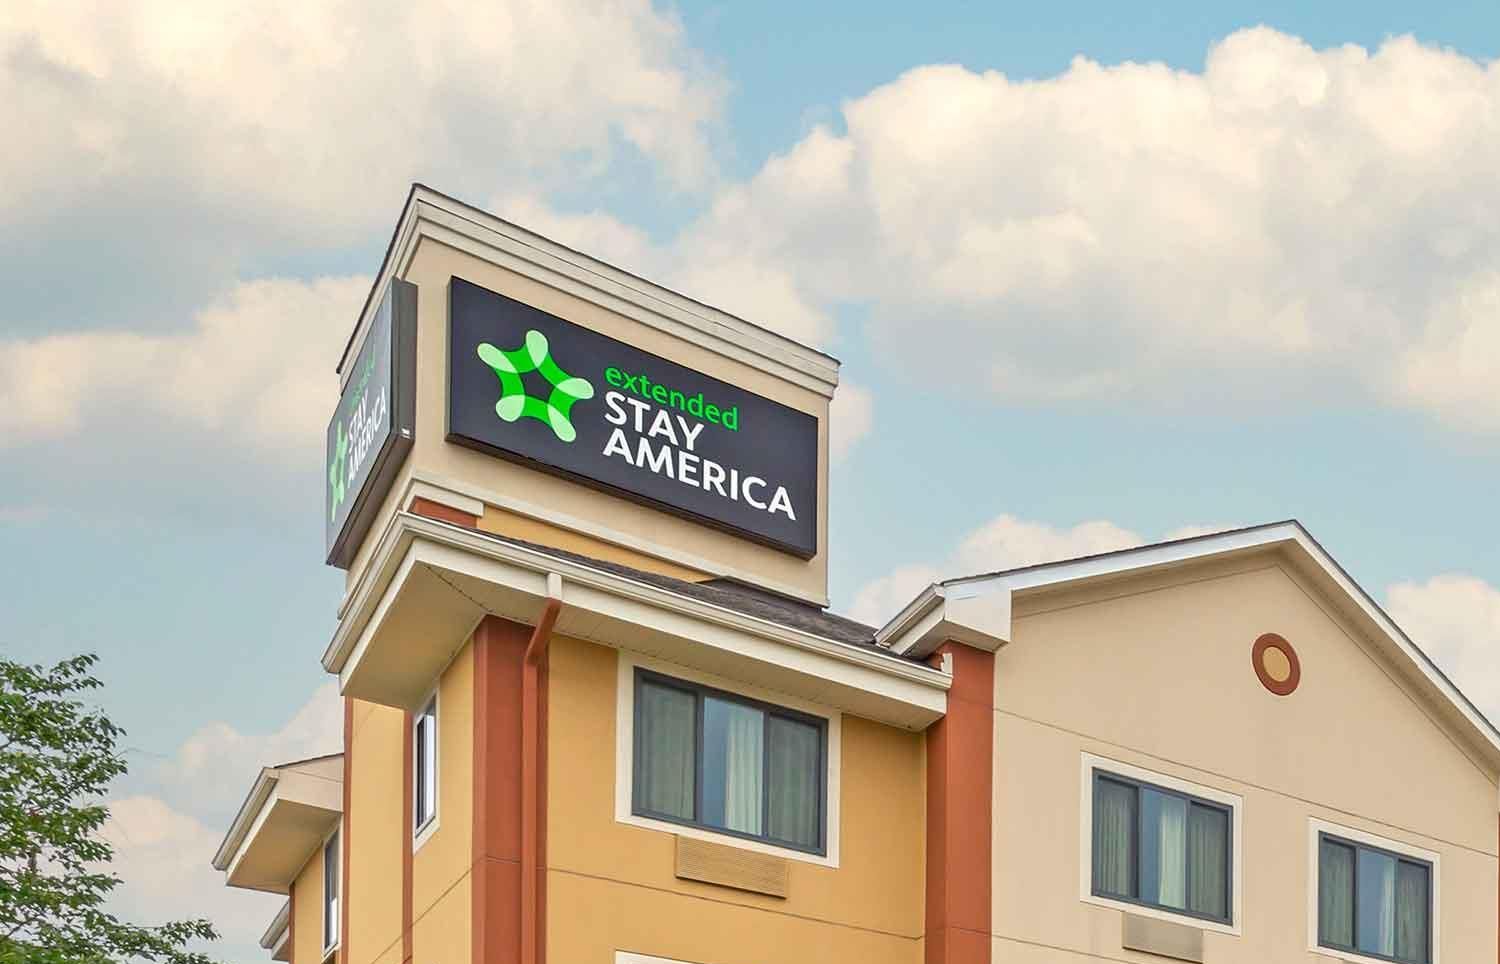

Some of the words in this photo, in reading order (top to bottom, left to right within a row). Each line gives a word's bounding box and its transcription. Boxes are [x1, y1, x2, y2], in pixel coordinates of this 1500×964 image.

[349, 387, 368, 453] STAY
[604, 391, 704, 451] STAY
[605, 367, 738, 432] extended
[347, 386, 385, 488] AMERICA
[603, 428, 796, 520] AMERICA
